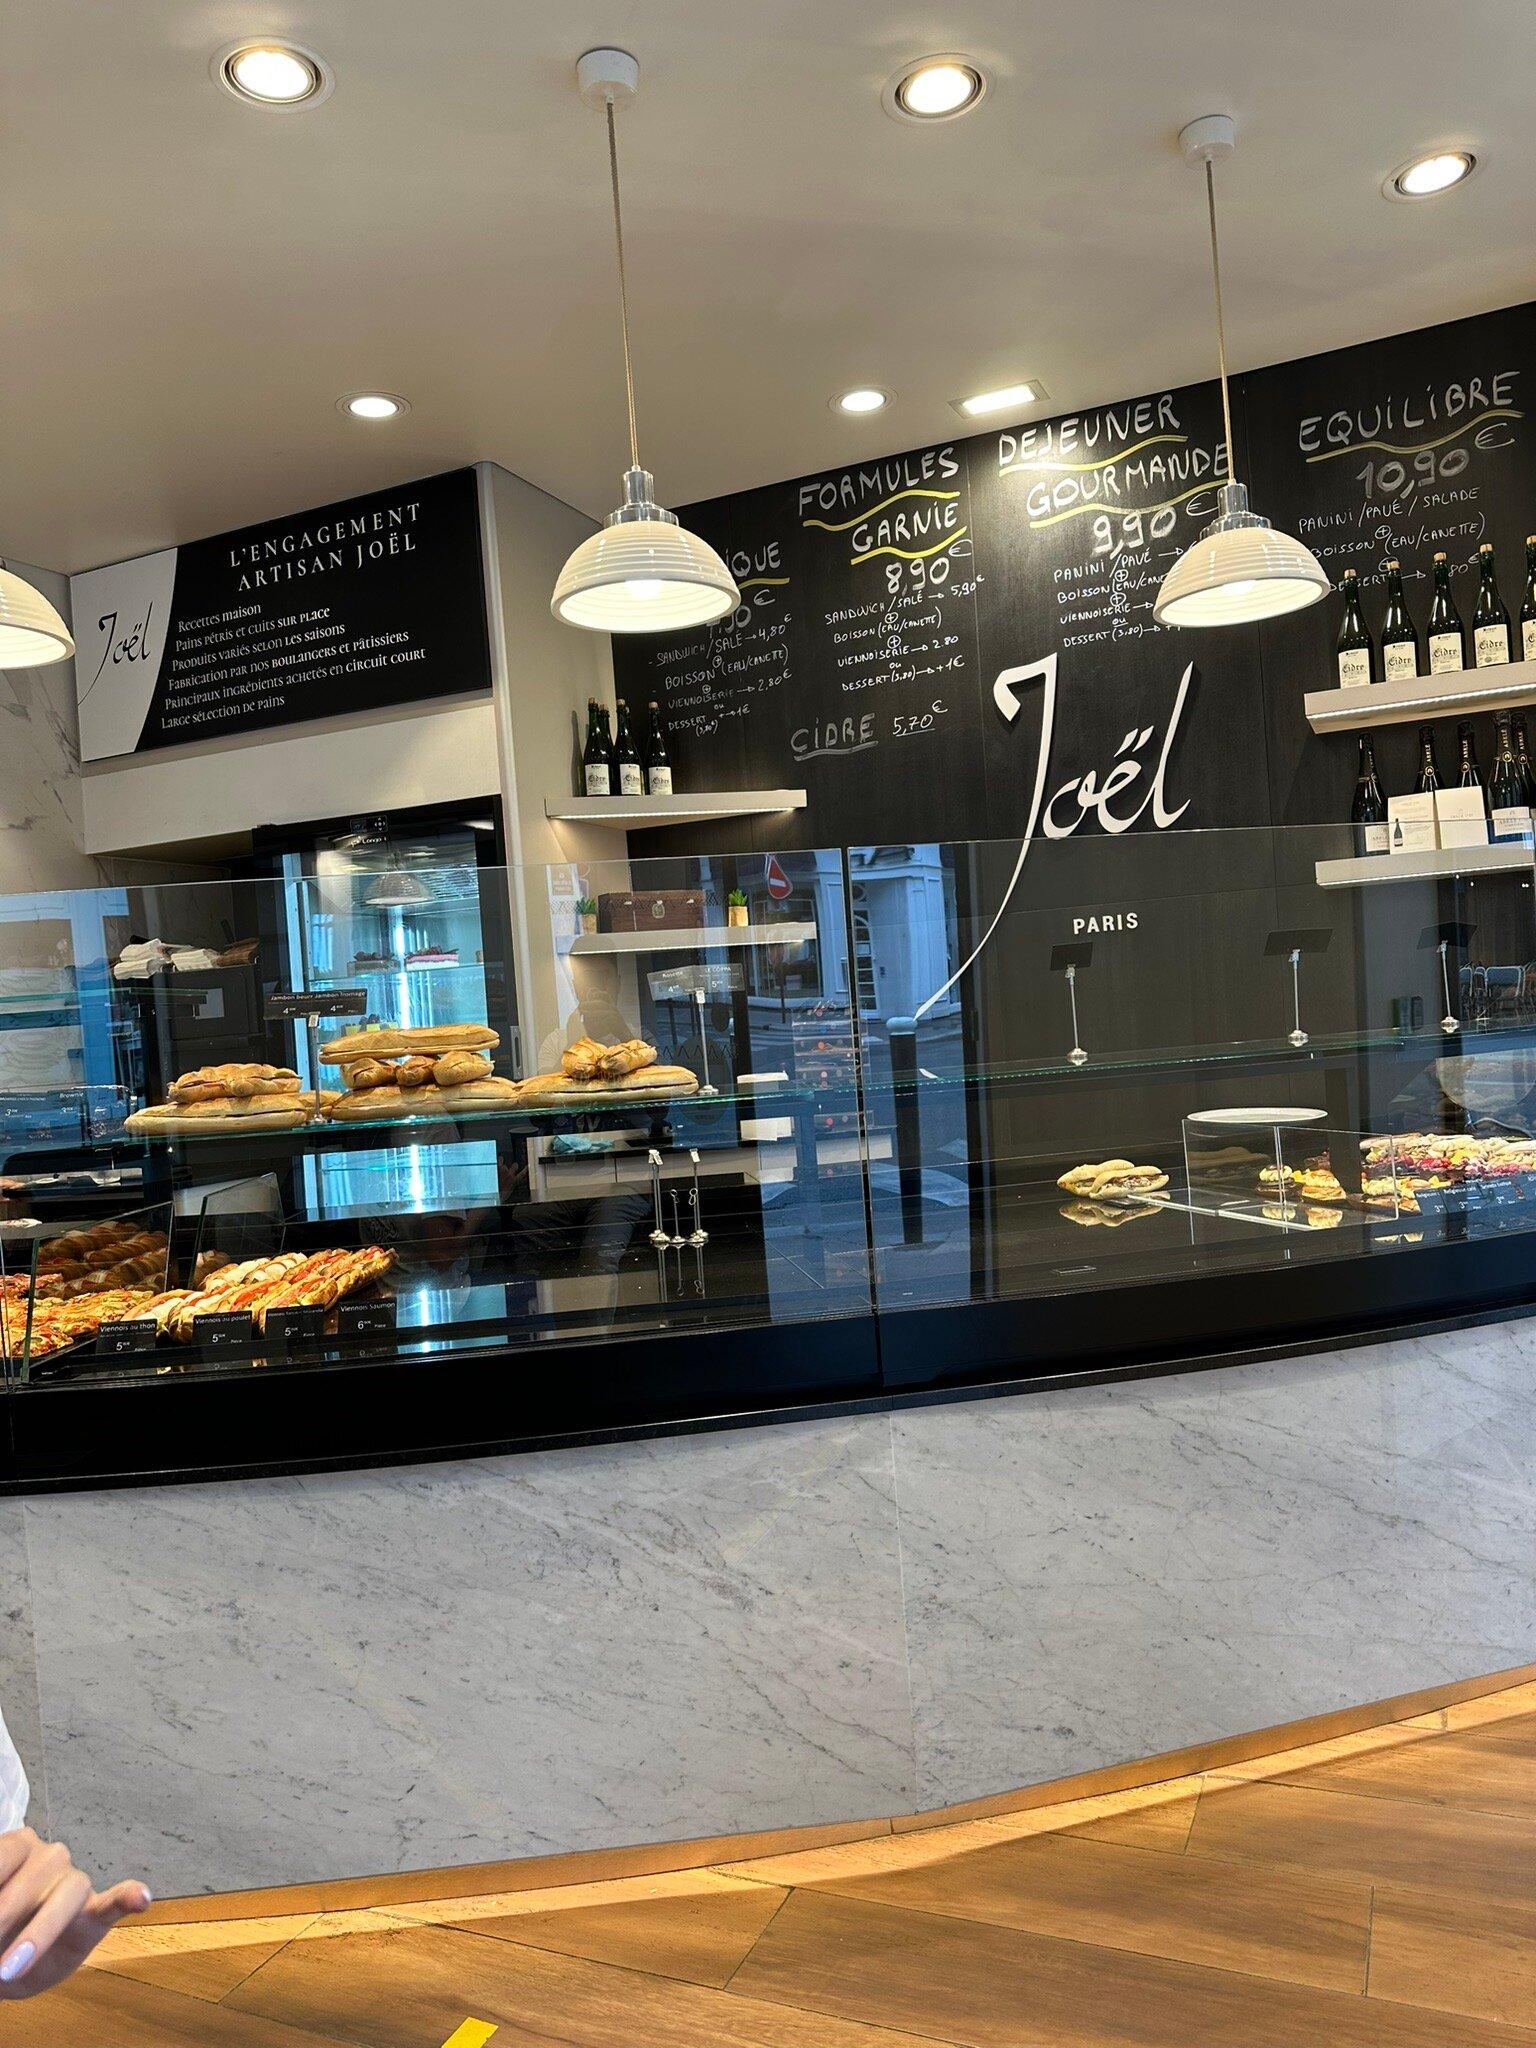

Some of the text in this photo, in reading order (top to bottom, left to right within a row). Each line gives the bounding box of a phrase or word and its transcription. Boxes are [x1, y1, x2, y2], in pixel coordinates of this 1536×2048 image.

[1299, 371, 1520, 452] EQUILIBRE
[999, 394, 1181, 466] DEJEUNER
[799, 446, 960, 516] FORMULES
[1026, 442, 1231, 517] GOURMANDE
[1423, 486, 1481, 508] SALADE
[230, 502, 421, 568] L'ENGAGEMENT
[852, 501, 959, 552] GARNIE
[238, 531, 417, 592] ARTISAN JOËL
[1057, 585, 1110, 604] BOISSON
[178, 604, 261, 633] Recettes maison
[1060, 603, 1131, 624] VIENNOISERIE
[172, 624, 346, 672] Produits variés selon les saisons
[175, 638, 203, 652] Pains
[235, 626, 246, 638] et
[247, 620, 276, 635] cuits
[833, 627, 876, 644] BOISSON
[1063, 630, 1111, 648] DESSERT
[168, 631, 410, 691] Fabrication par nos boulangers et pâtissiers
[838, 645, 910, 668] VIENNOISERIE
[165, 648, 427, 710] Principaux ingrédients achetés en circuit court
[665, 669, 716, 690] BOISSON
[842, 674, 891, 692] DESSERT
[161, 695, 285, 729] Large sélection de pains
[668, 714, 707, 731] DESSERT
[790, 712, 876, 753] CIDRE
[1073, 912, 1139, 935] PARIS
